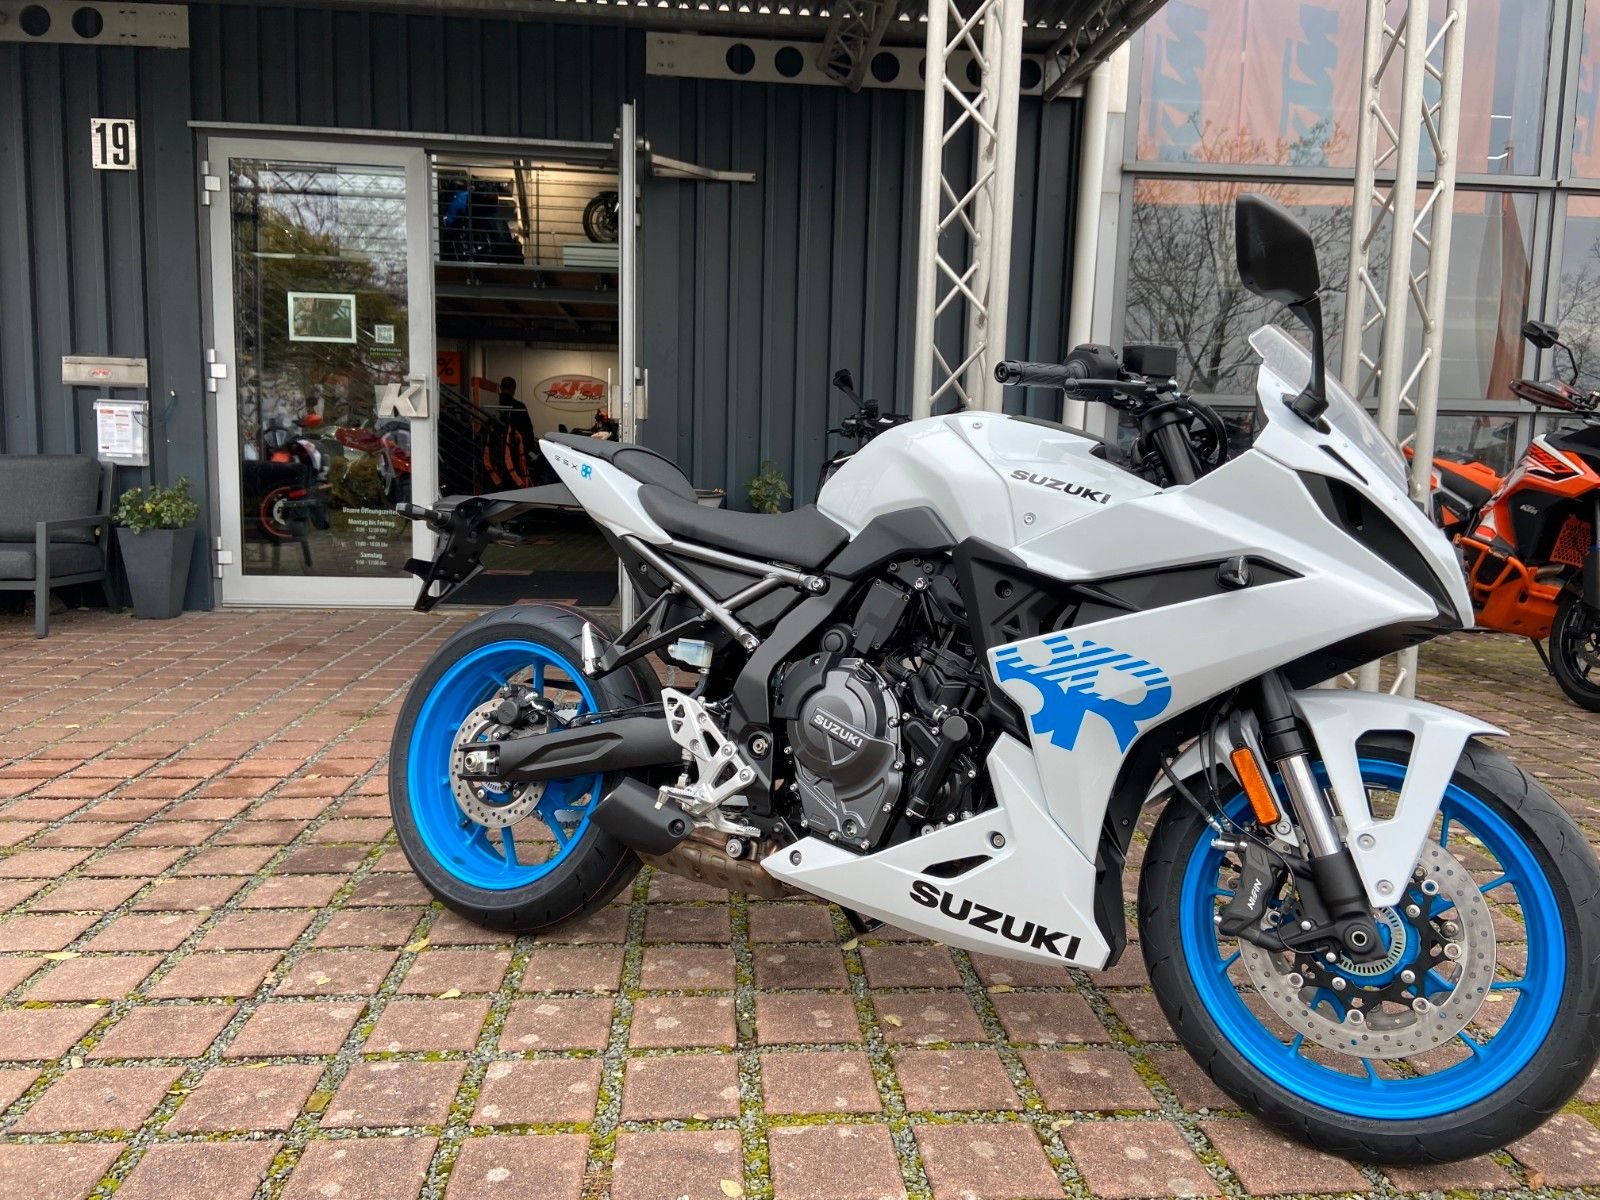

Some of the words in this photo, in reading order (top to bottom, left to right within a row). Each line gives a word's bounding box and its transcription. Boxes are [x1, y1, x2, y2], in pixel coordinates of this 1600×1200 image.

[96, 123, 130, 165] 19
[549, 380, 604, 396] KTM
[1010, 469, 1112, 505] SUZUKI
[1519, 504, 1539, 515] KTM
[348, 518, 368, 527] Montag
[361, 552, 383, 560] Samstag
[813, 714, 864, 748] SUZUKI
[909, 879, 1082, 961] SUZUKI
